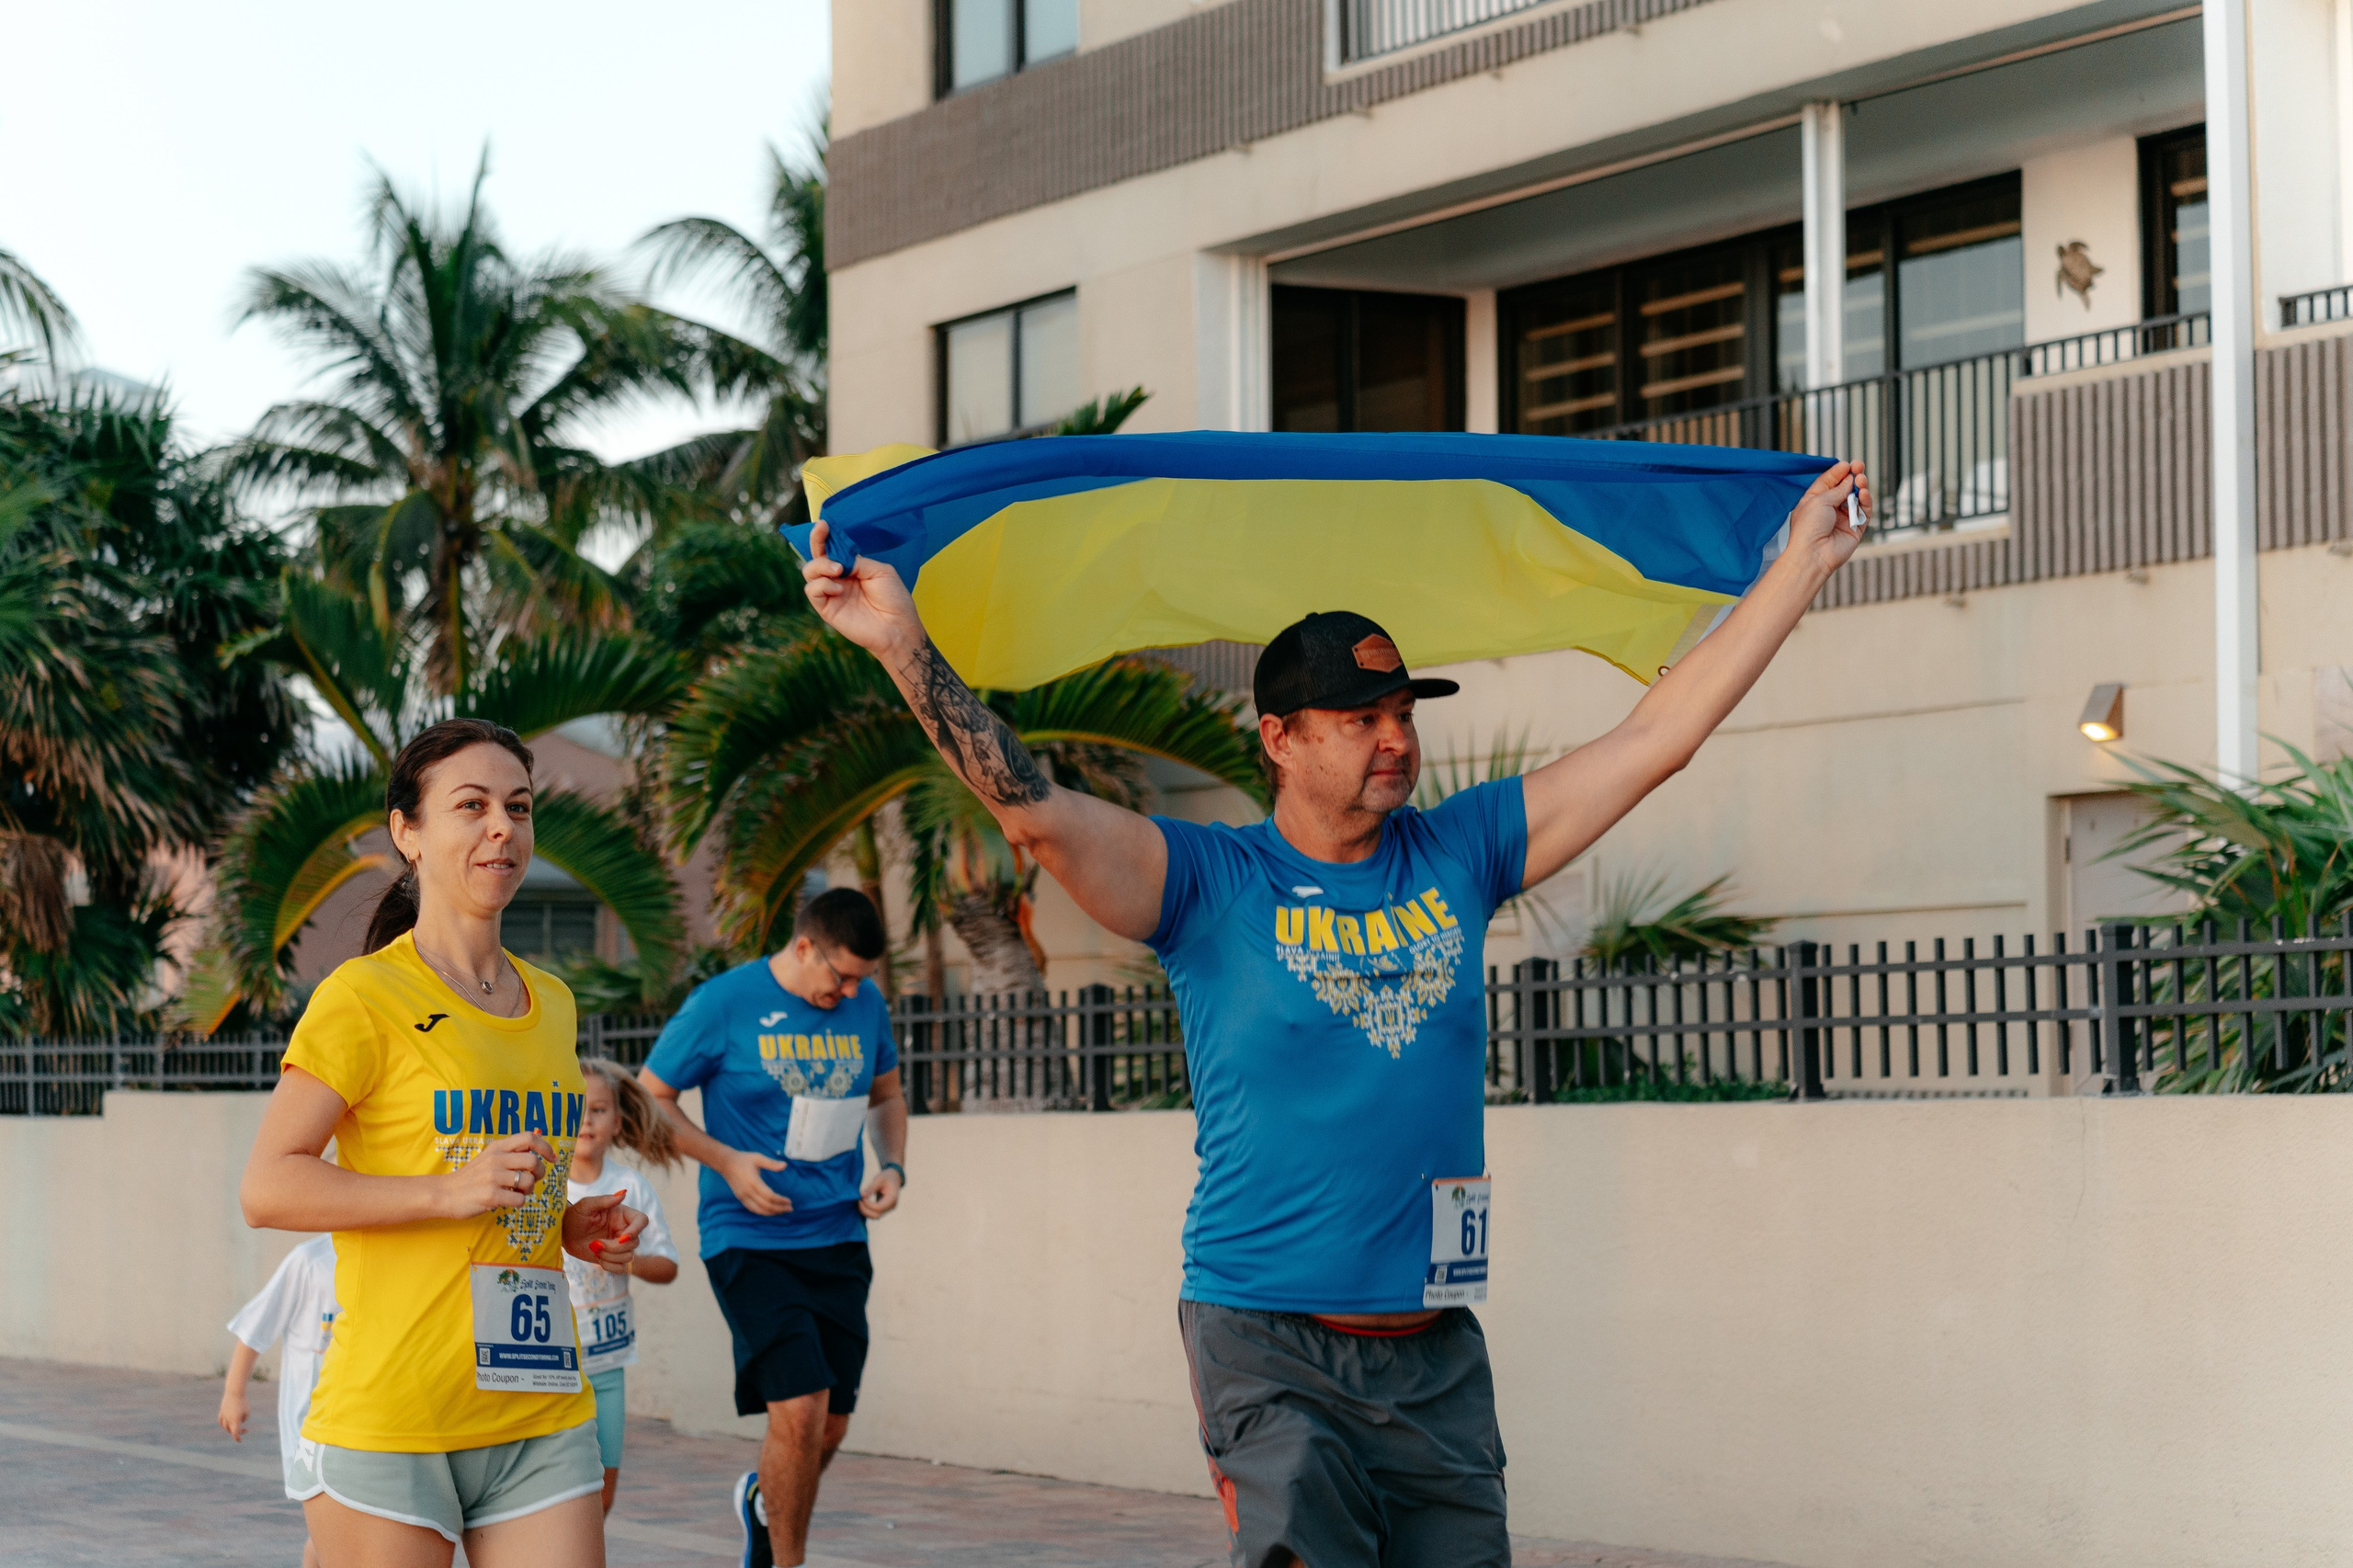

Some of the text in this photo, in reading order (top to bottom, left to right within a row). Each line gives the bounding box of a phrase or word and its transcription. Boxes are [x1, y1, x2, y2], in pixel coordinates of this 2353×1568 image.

[1275, 887, 1459, 956] UKRAINE
[757, 1028, 864, 1061] UKRAINE
[435, 1136, 460, 1146] SLAVA
[1461, 1207, 1487, 1256] 61
[510, 1293, 551, 1343] 65
[592, 1311, 627, 1342] 105
[492, 1371, 519, 1385] Coupon
